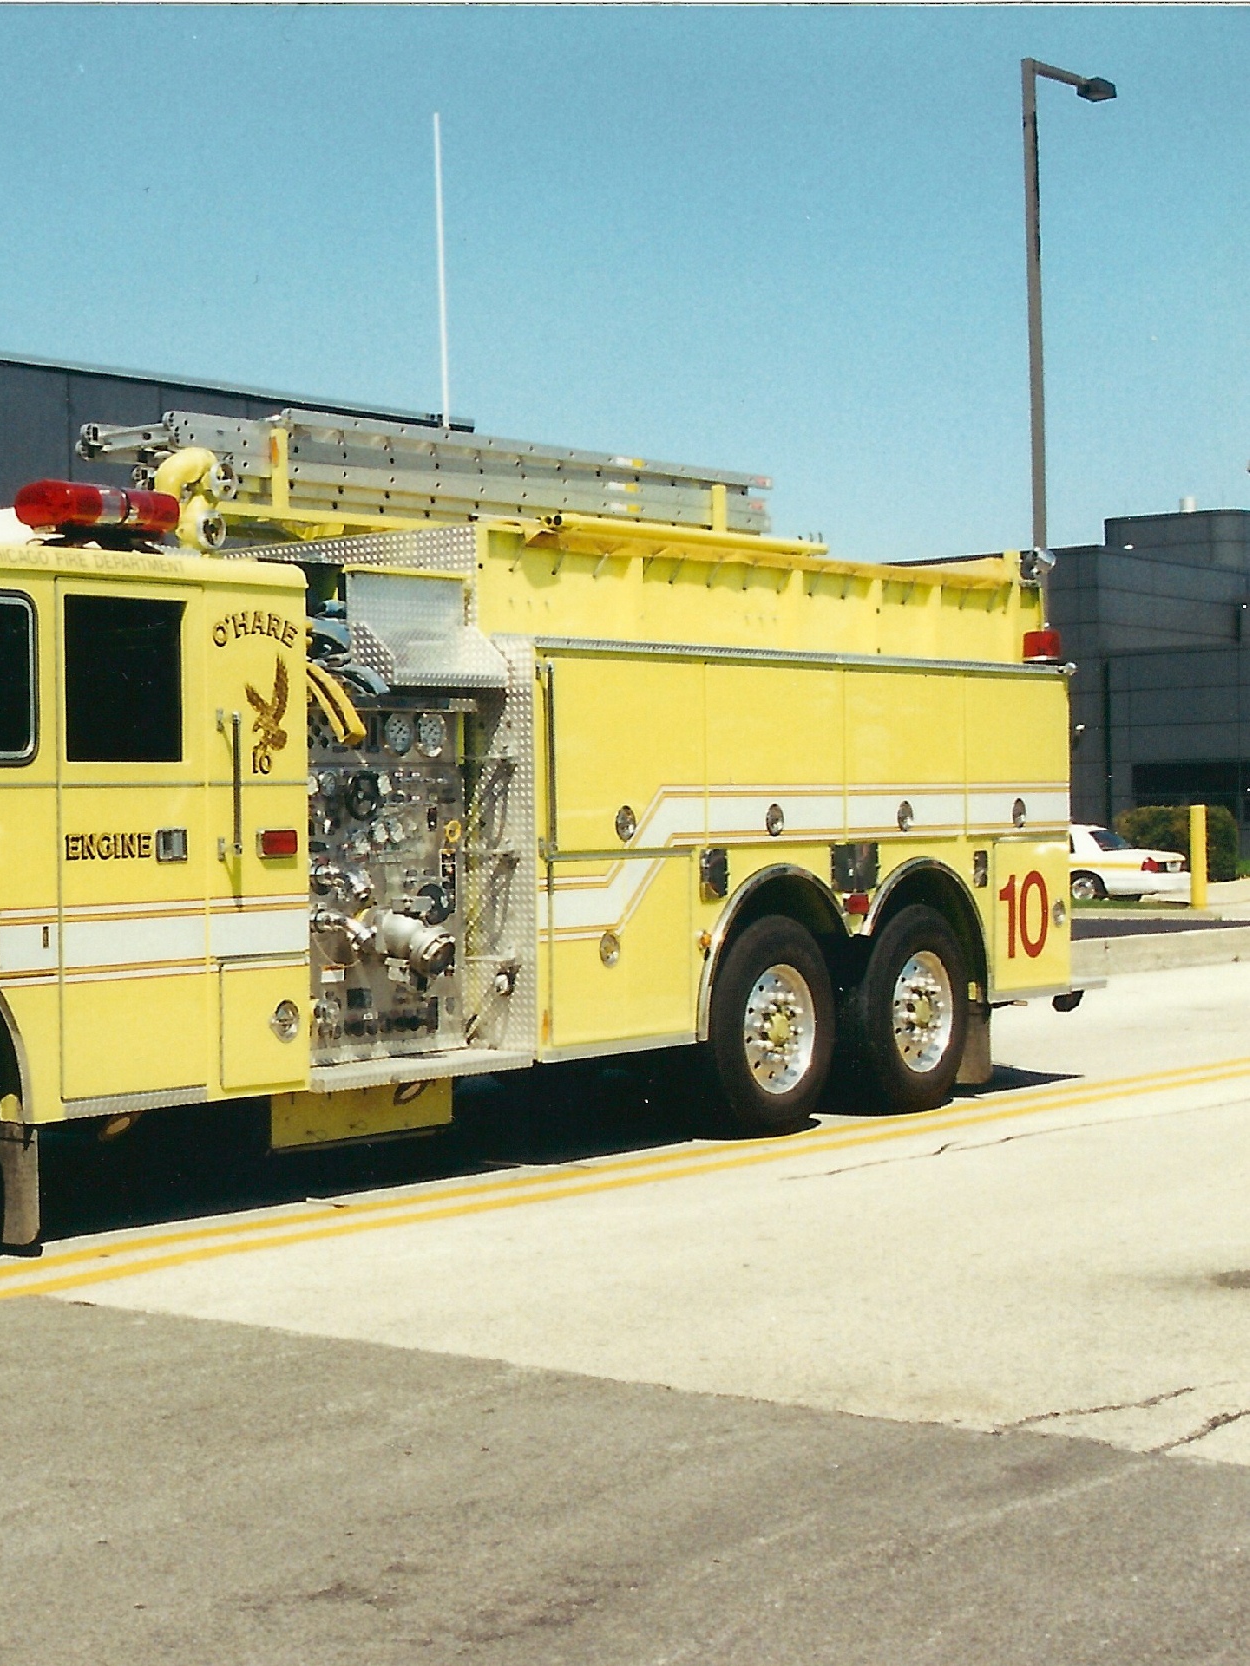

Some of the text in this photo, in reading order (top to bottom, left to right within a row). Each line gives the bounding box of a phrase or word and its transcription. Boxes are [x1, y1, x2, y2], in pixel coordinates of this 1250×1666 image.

[55, 552, 90, 568] FIRE
[93, 553, 186, 574] DEPARTMENT
[212, 610, 299, 649] O'HARE
[64, 831, 153, 861] ENGINE
[998, 870, 1049, 959] 10
